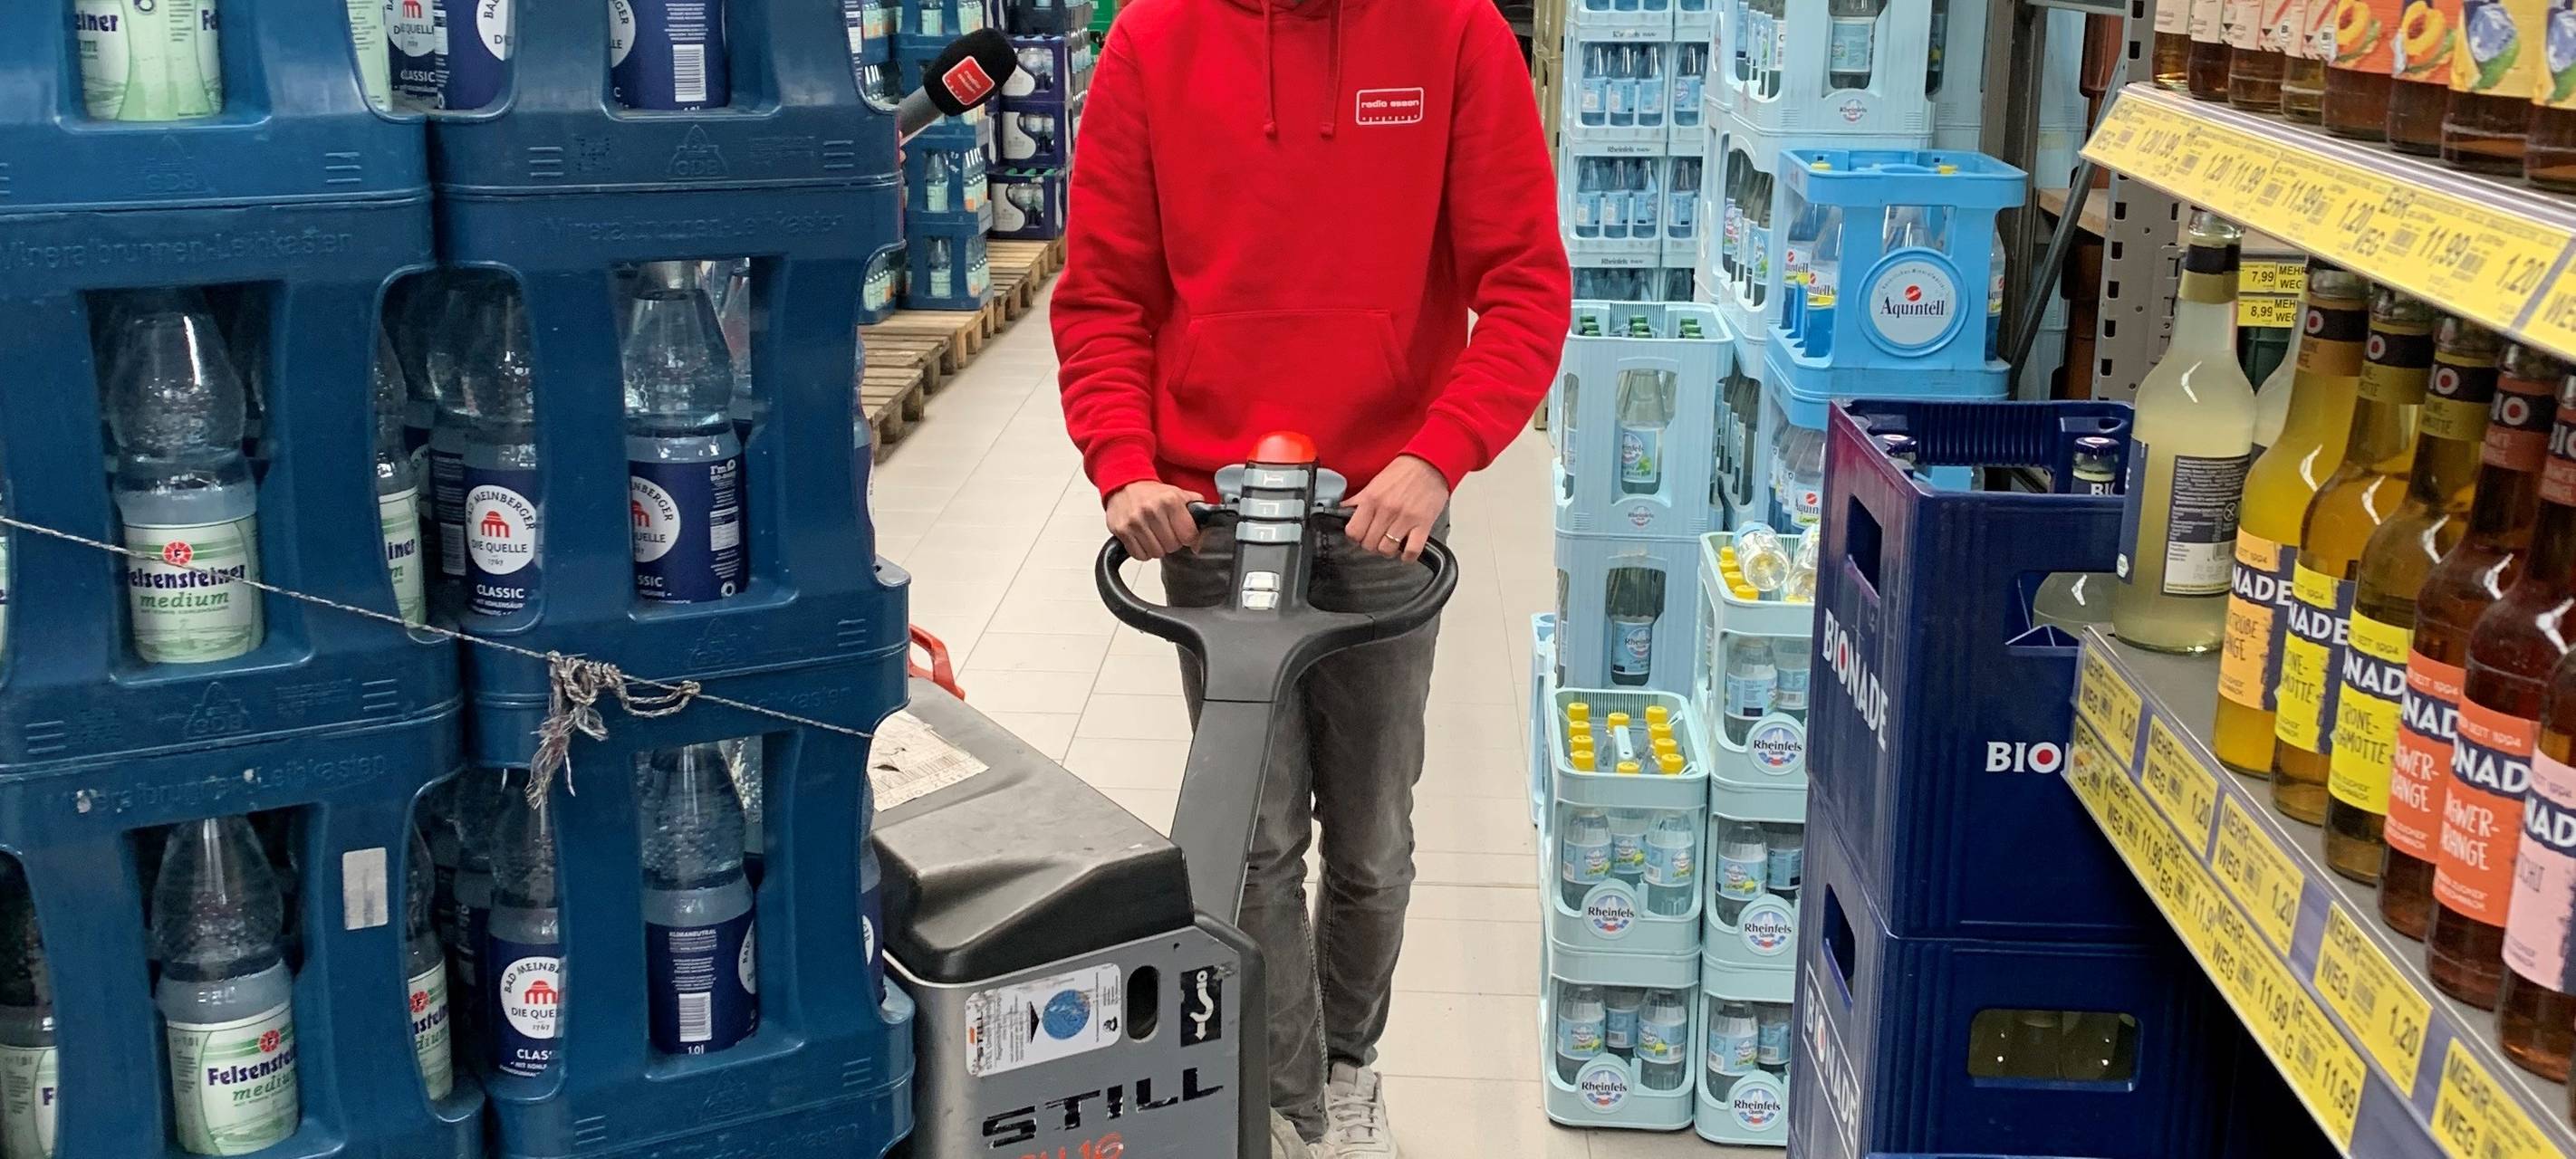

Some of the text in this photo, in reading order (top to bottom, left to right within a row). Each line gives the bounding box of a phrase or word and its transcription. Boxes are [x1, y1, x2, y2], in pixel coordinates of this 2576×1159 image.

[1361, 100, 1419, 109] radio essen
[2252, 271, 2274, 283] 7,99
[2250, 306, 2273, 319] 8,99
[2274, 299, 2296, 309] MEH
[474, 491, 536, 531] MEINBERGER
[631, 481, 674, 522] NBERGER
[1795, 498, 1819, 514] Aquin
[485, 541, 528, 554] QUELLE
[634, 532, 667, 544] UELLE
[129, 564, 245, 589] elsensteiner
[476, 584, 525, 599] CLASSIC
[637, 575, 664, 588] SSIC
[140, 591, 229, 608] medium
[2375, 641, 2399, 655] 1994
[1821, 608, 1889, 752] BIONADE
[2343, 648, 2407, 697] NAD
[2402, 690, 2460, 740] NAD
[1754, 739, 1802, 752] Rheinfels
[1985, 741, 2070, 774] BIO
[2149, 723, 2174, 767] MEHR
[2492, 732, 2522, 748] 1994
[2146, 758, 2167, 795] WEG
[2453, 739, 2531, 794] NAD
[2191, 790, 2211, 831] 1,20
[2222, 803, 2251, 851] MEHR
[2524, 794, 2576, 849] NAD
[2219, 839, 2241, 884] WEG
[2159, 868, 2172, 899] EG
[1588, 905, 1635, 918] Rheinfels
[2194, 891, 2216, 934] 11,9
[2218, 898, 2245, 952] MEHR
[2271, 881, 2296, 929] 1,20
[1744, 923, 1793, 934] Rheinfels
[2329, 908, 2361, 963] MEHR
[2212, 940, 2235, 982] WEG
[2321, 953, 2350, 1001] WEG
[511, 1007, 555, 1020] DIE QUE
[2259, 976, 2289, 1030] 11,99
[2389, 1003, 2420, 1059] 1,20
[1581, 1081, 1628, 1093] Rheinfels
[2321, 1058, 2357, 1120] 11,99
[2448, 1049, 2491, 1120] MEHR
[982, 1068, 1224, 1149] STILL
[1734, 1099, 1781, 1112] Rheinfels
[2441, 1097, 2477, 1157] WEG
